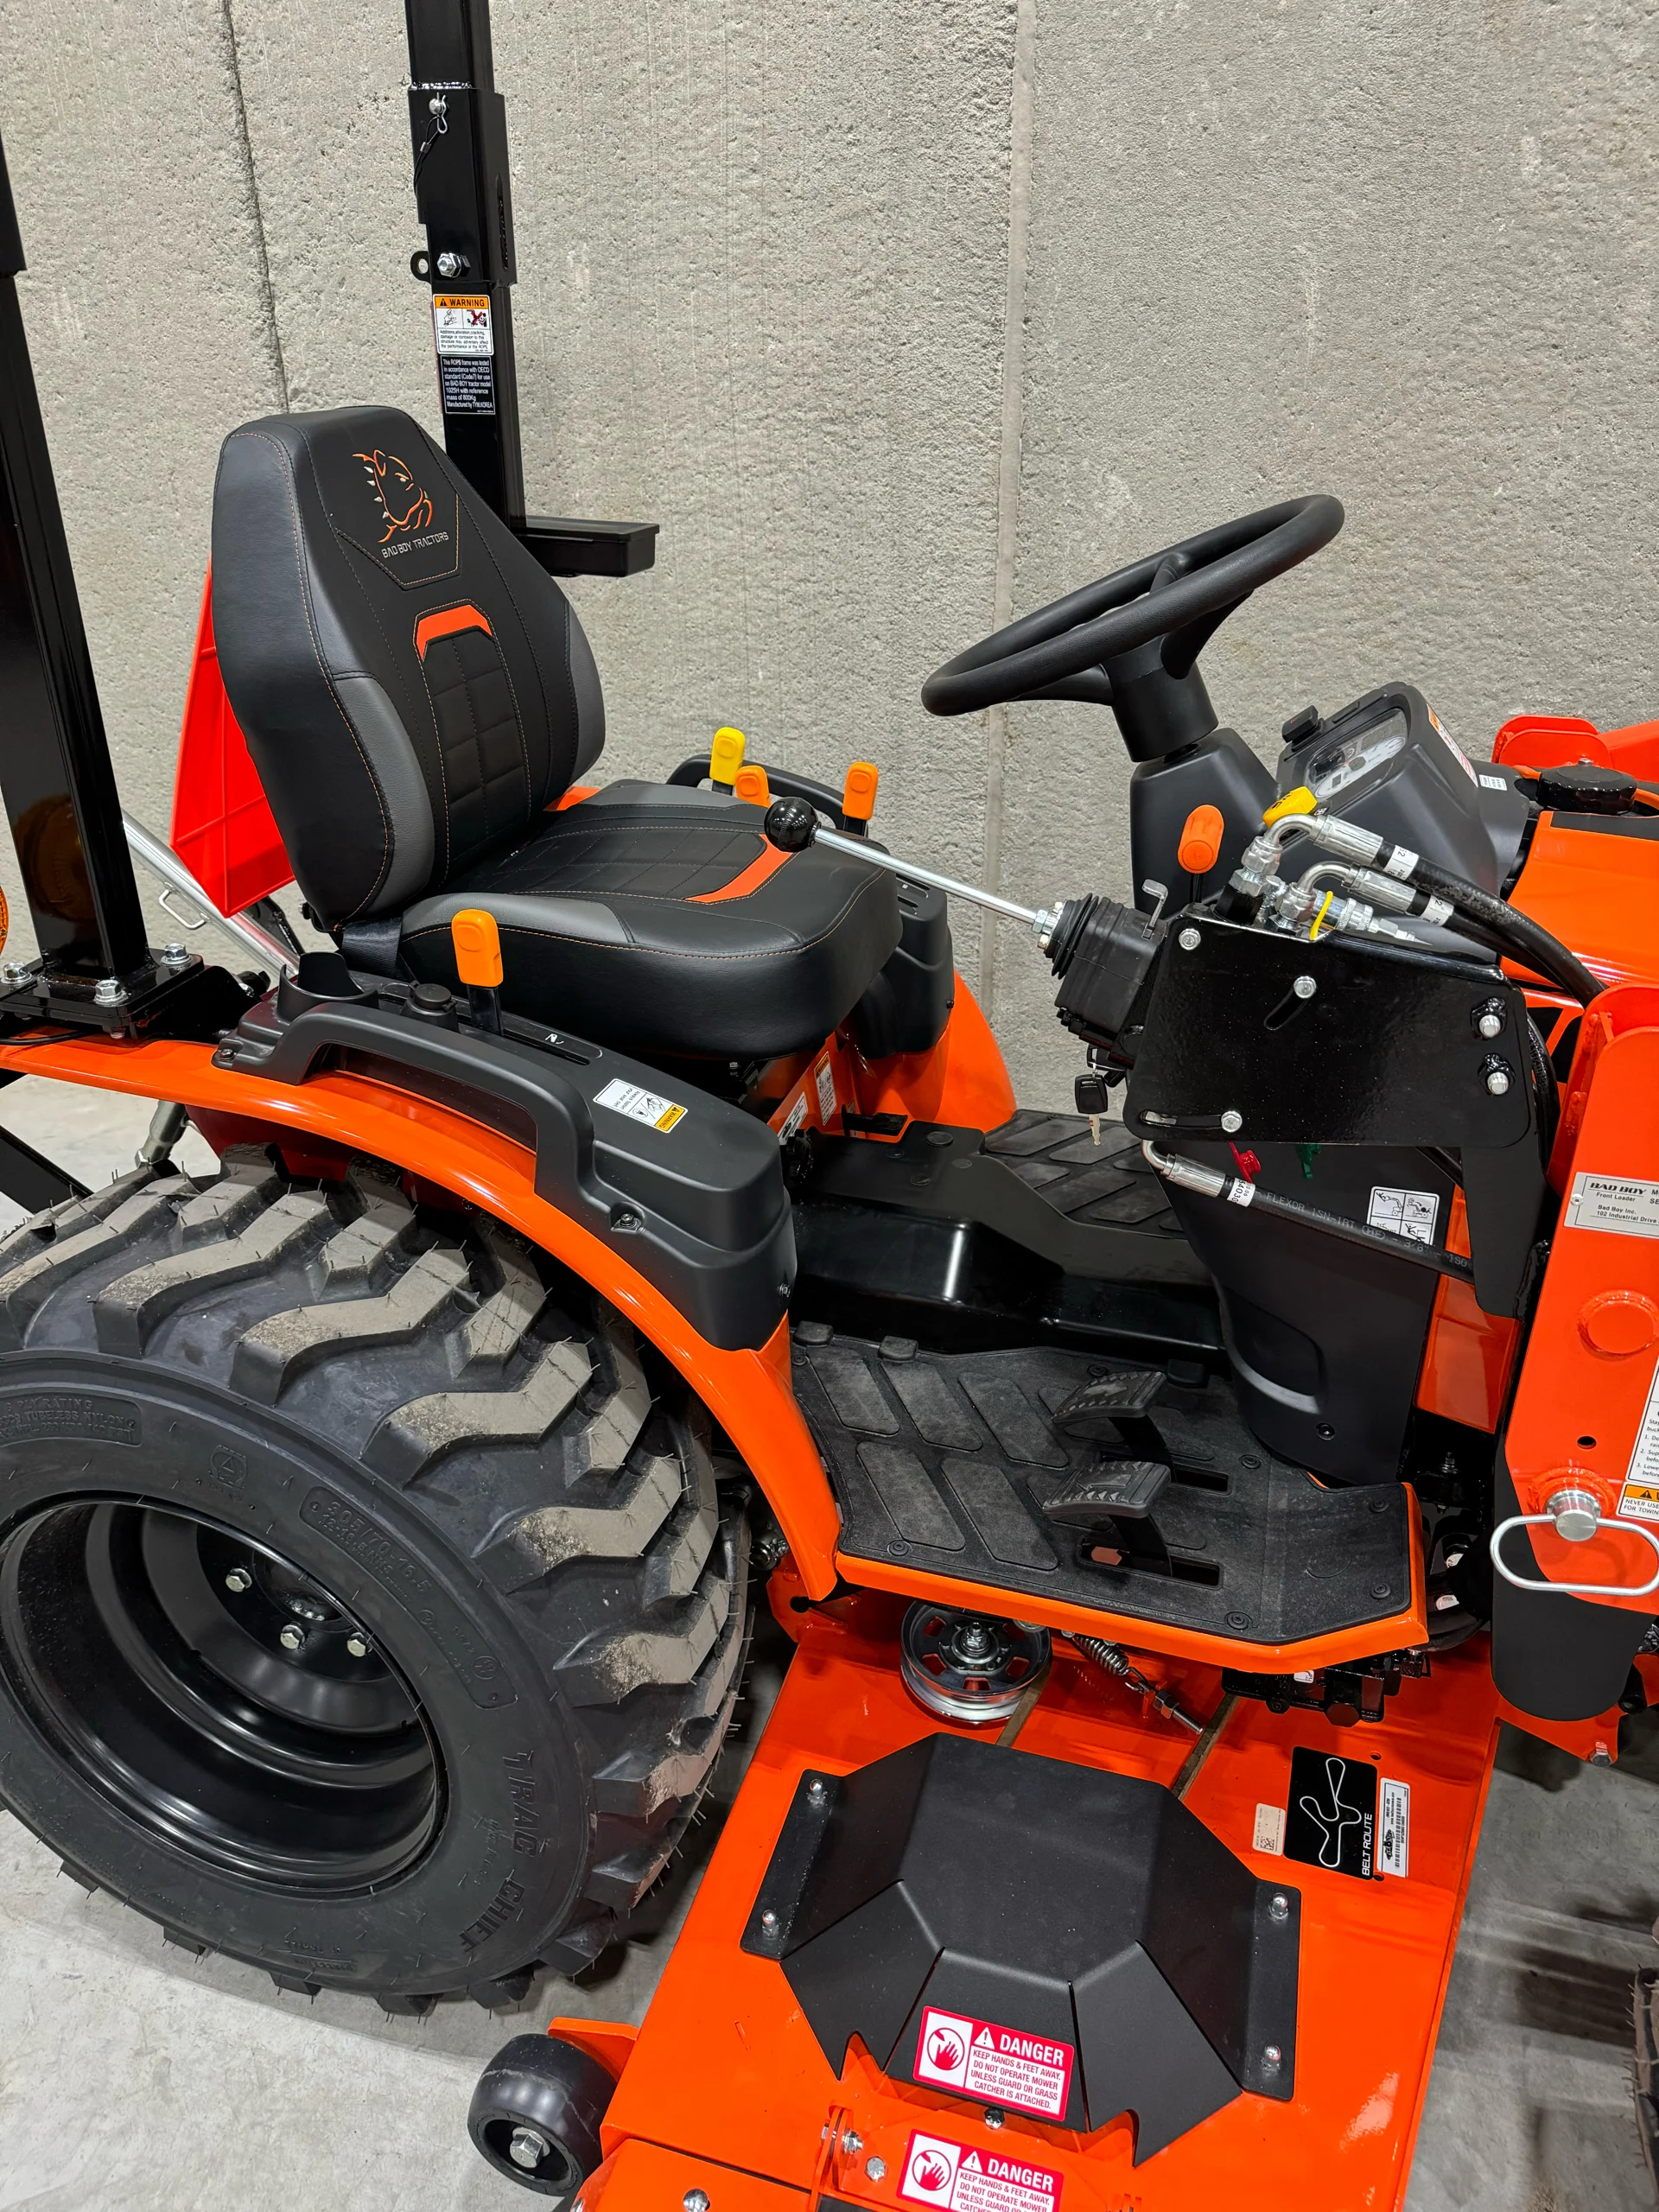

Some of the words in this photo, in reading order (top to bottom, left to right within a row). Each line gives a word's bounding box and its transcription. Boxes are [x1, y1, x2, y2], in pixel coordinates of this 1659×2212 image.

[449, 298, 485, 307] WARNING
[381, 545, 398, 558] BAD
[399, 541, 413, 553] BOY
[413, 531, 449, 548] TRACTORS
[1266, 1192, 1305, 1211] FLEXOR
[1590, 1182, 1617, 1191] BAD
[1619, 1186, 1647, 1195] BOY
[1609, 1212, 1638, 1221] Industrial
[25, 1410, 79, 1421] TUBELESS
[42, 1398, 93, 1409] RATING
[502, 1750, 540, 1857] TRAC
[1363, 1813, 1372, 1850] ROUTE
[1361, 1850, 1371, 1876] BELT
[459, 1880, 525, 1953] CHIEF
[973, 2049, 990, 2061] KEEP
[992, 2054, 1014, 2067] HANDS
[1023, 2063, 1039, 2074] FEET
[1040, 2067, 1061, 2081] AWAY.
[999, 2034, 1064, 2067] DANGER
[971, 2070, 997, 2083] UNLESS
[998, 2077, 1022, 2090] GUARD
[1024, 2083, 1033, 2093] OR
[1035, 2086, 1058, 2100] GRASS
[974, 2060, 983, 2070] DO
[985, 2063, 999, 2074] NOT
[1000, 2067, 1030, 2082] OPERATE
[1032, 2075, 1058, 2090] MOWER
[974, 2081, 1005, 2096] CATCHER
[1007, 2088, 1013, 2097] IS
[1014, 2091, 1051, 2109] ATTACHED.
[960, 2172, 977, 2182] KEEP
[978, 2177, 1002, 2190] HANDS
[1011, 2187, 1028, 2198] FEET
[1029, 2193, 1049, 2205] AWAY.
[987, 2158, 1054, 2193] DANGER
[957, 2191, 984, 2205] UNLESS
[985, 2199, 1009, 2212] GUARD
[960, 2182, 970, 2191] DO
[972, 2185, 986, 2195] NOT
[987, 2190, 1018, 2206] OPERATE
[1020, 2200, 1047, 2212] MOWER
